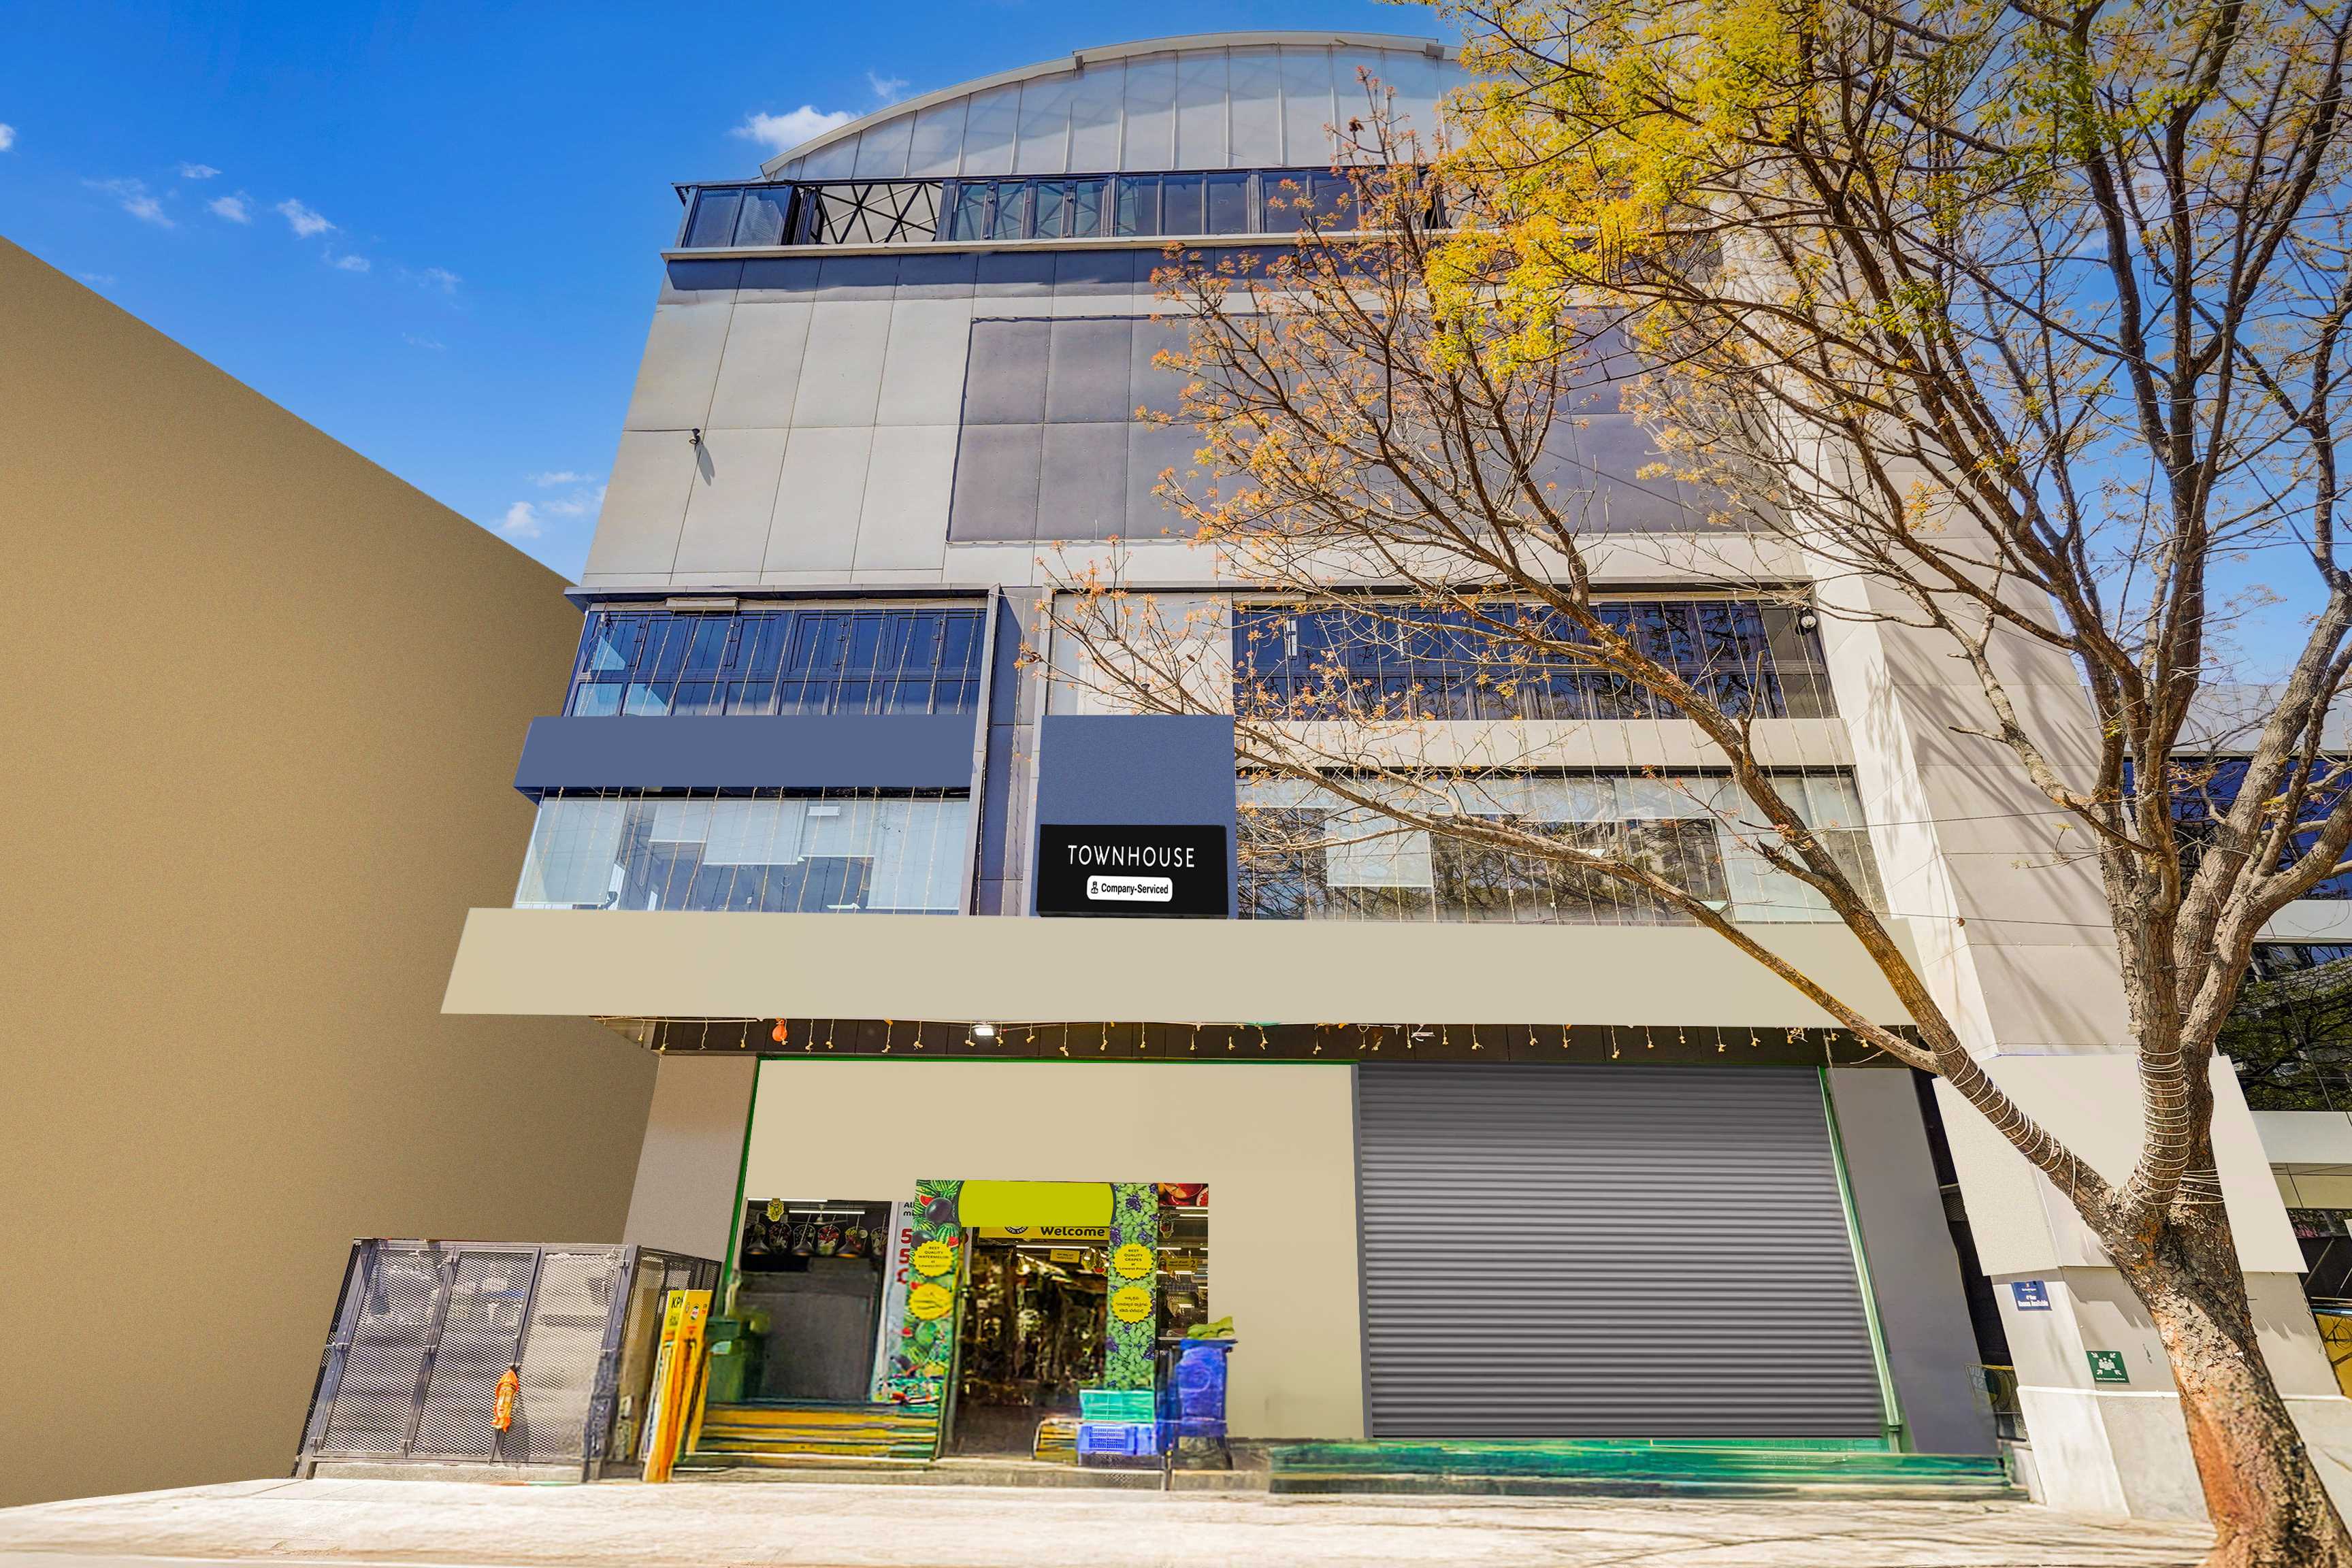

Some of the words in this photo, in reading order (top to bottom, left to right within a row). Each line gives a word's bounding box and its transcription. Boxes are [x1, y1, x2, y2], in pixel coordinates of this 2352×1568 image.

[1068, 845, 1195, 868] TOWNHOUSE
[1101, 883, 1169, 895] Company-Serviced
[1041, 1227, 1105, 1237] Welcome
